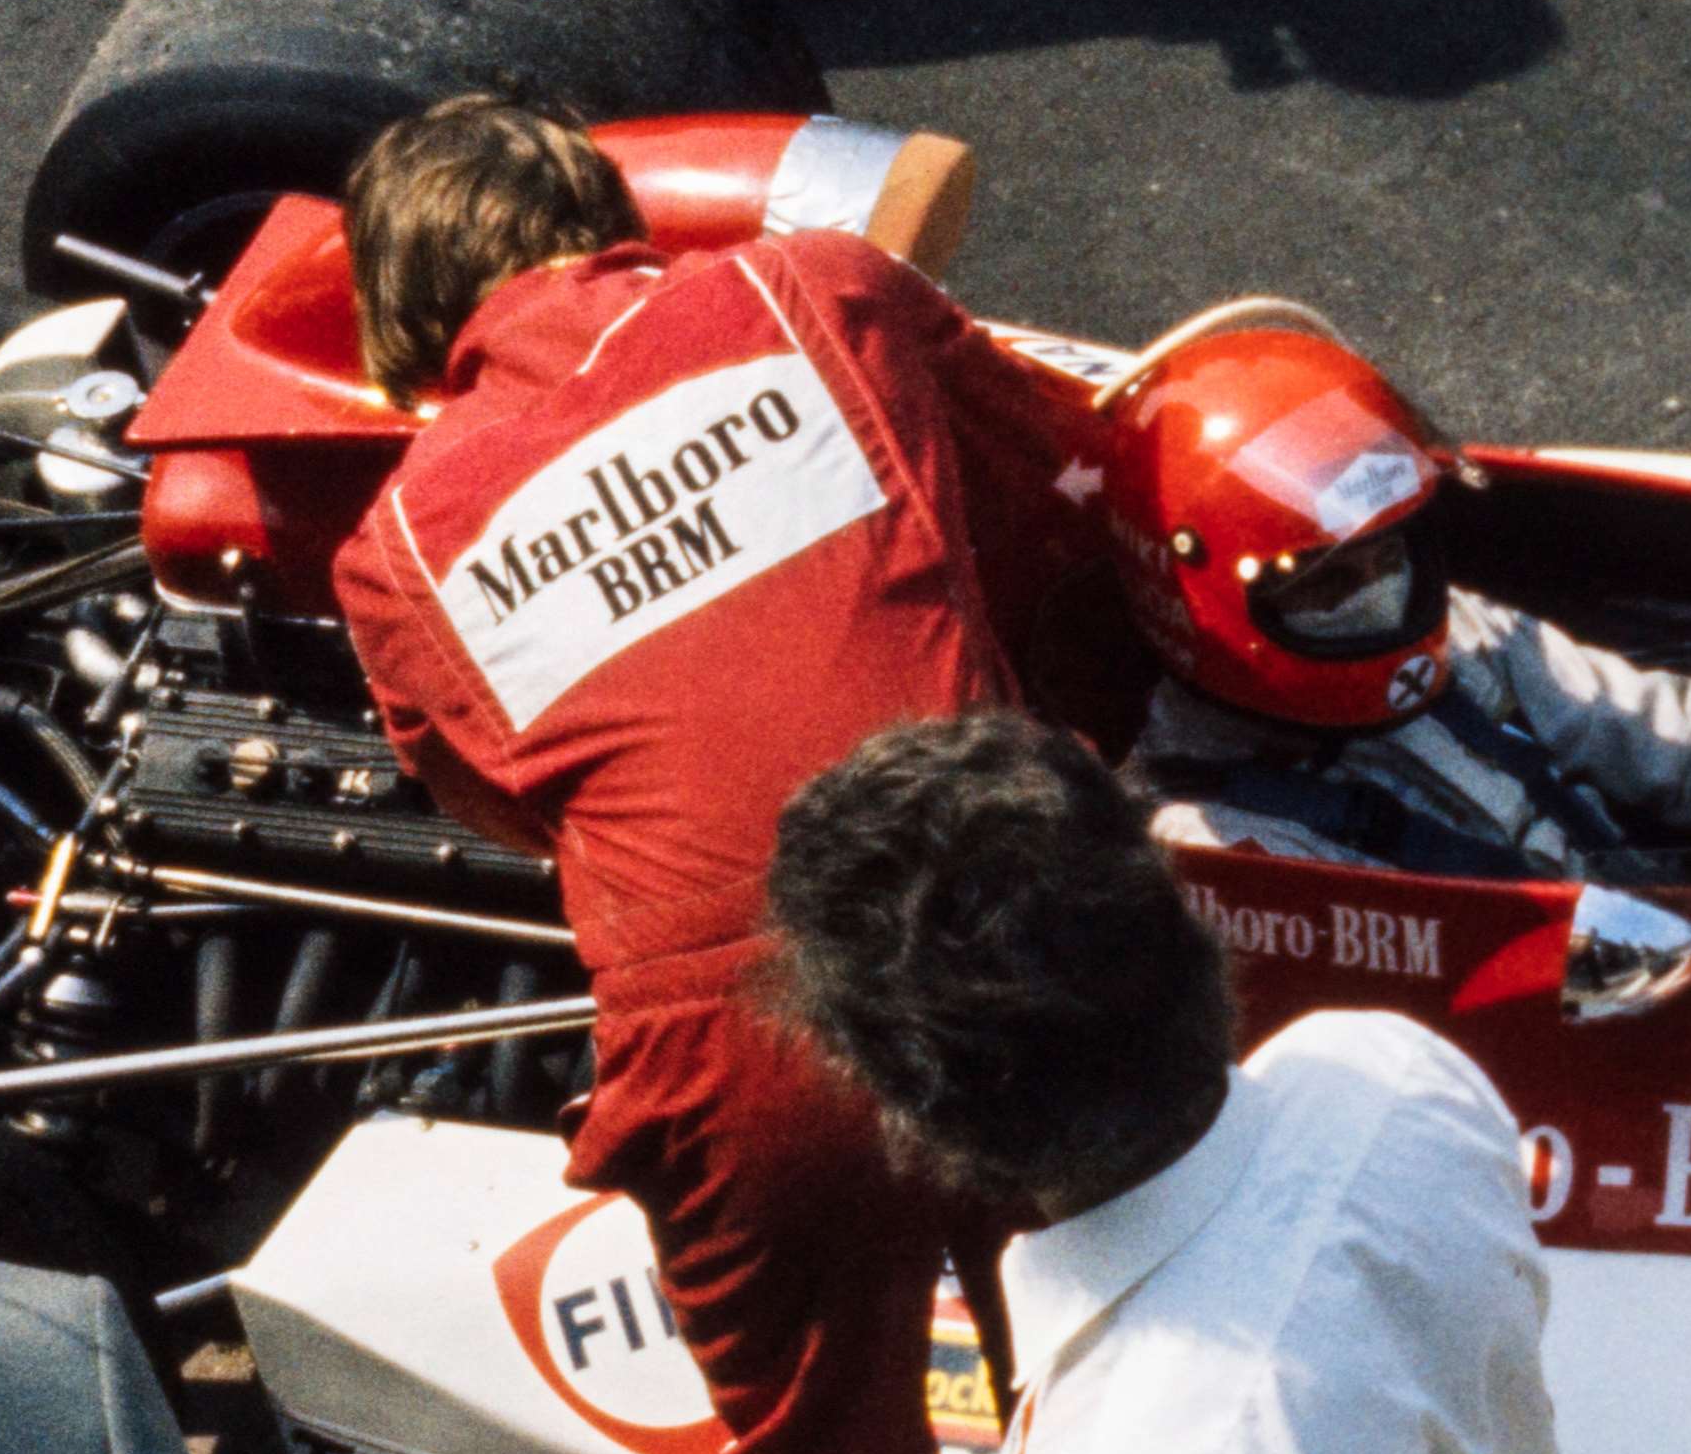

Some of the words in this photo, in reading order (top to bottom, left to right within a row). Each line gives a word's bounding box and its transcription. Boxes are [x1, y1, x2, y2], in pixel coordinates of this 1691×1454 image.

[465, 388, 800, 627] Marlboro
[584, 496, 743, 625] BRM
[1182, 881, 1443, 979] lboro-BRM
